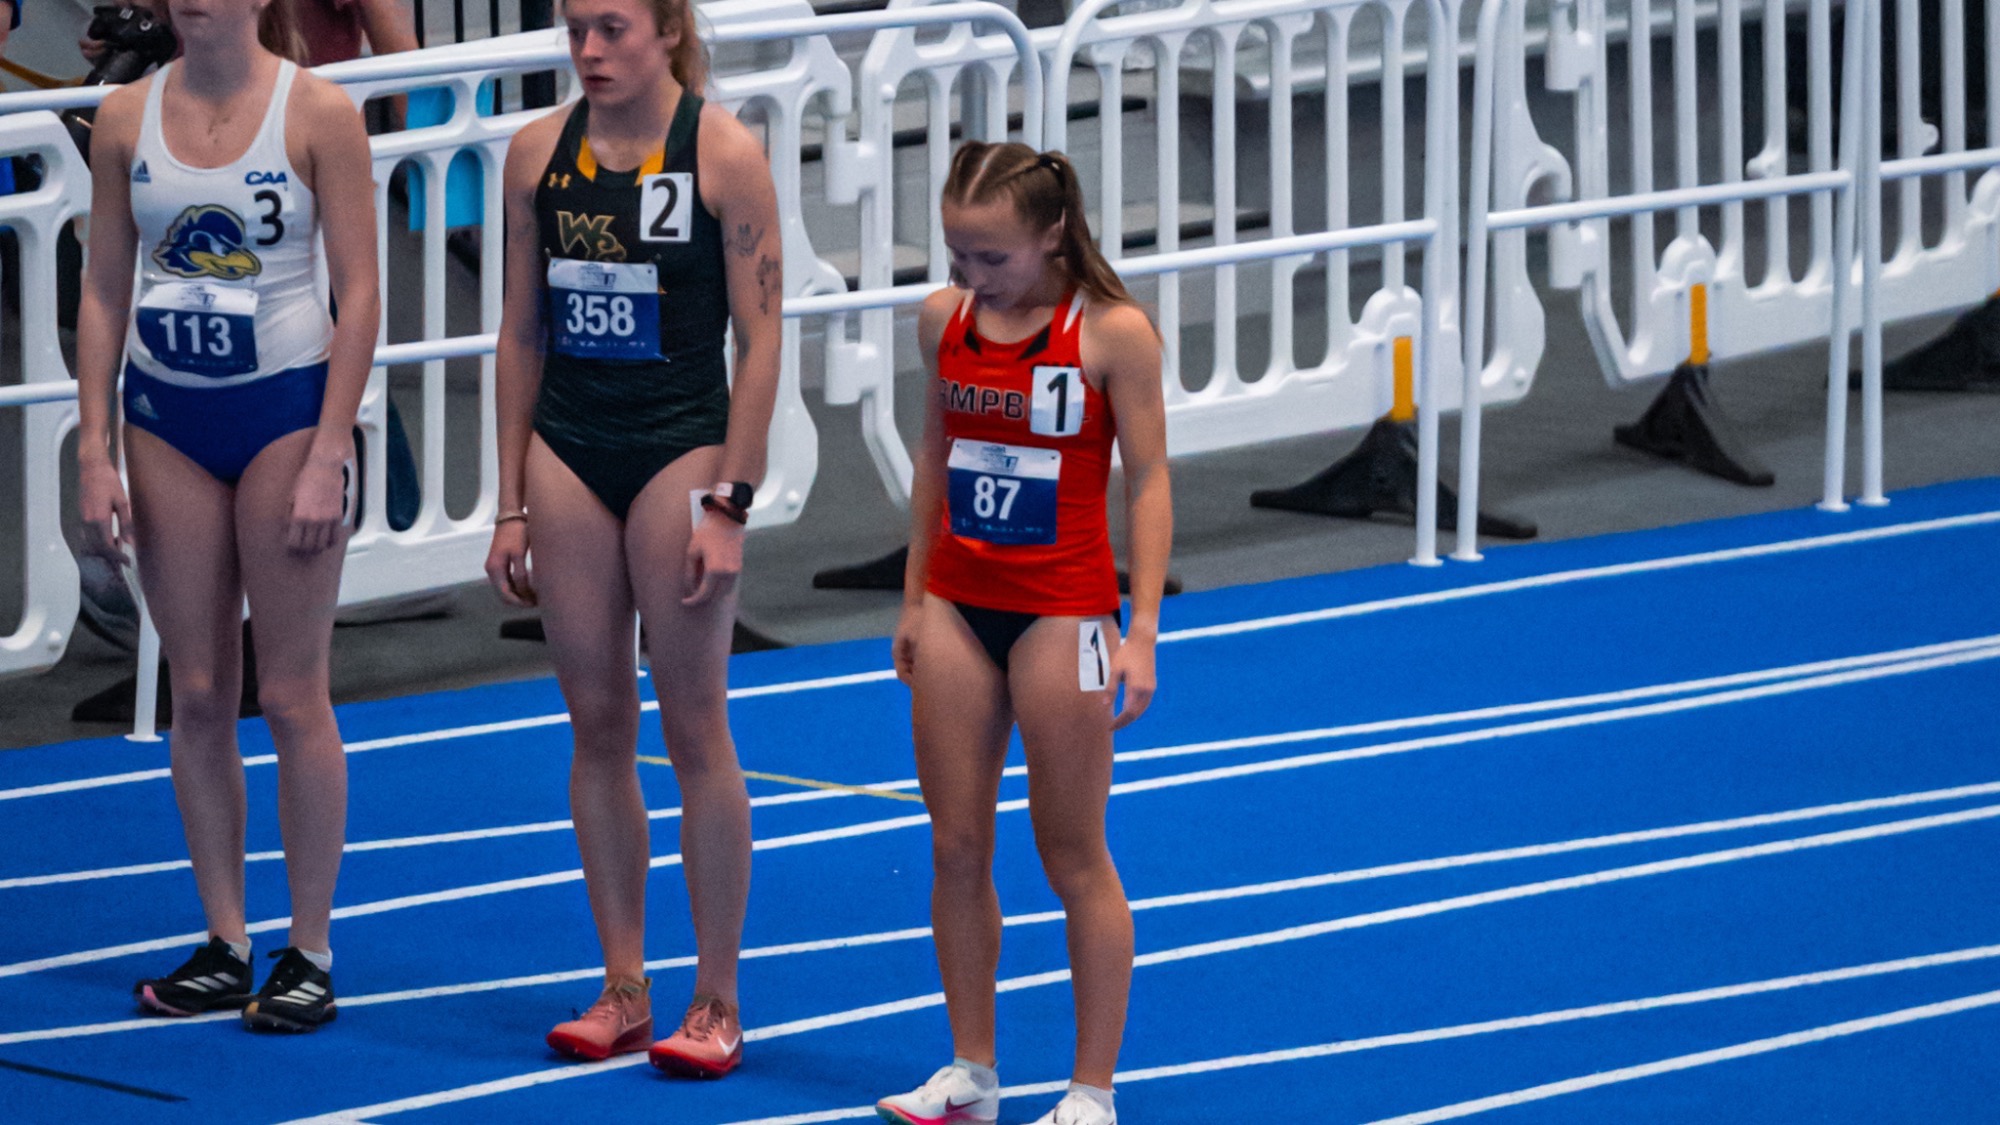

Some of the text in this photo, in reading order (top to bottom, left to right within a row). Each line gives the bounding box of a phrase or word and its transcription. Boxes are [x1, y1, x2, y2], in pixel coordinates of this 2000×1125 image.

[244, 170, 288, 186] CAA
[254, 189, 285, 246] 3
[649, 176, 679, 237] 2
[158, 312, 233, 357] 113
[566, 292, 636, 336] 358
[1046, 372, 1068, 432] 1
[973, 475, 1021, 520] 87
[1090, 626, 1105, 686] 1
